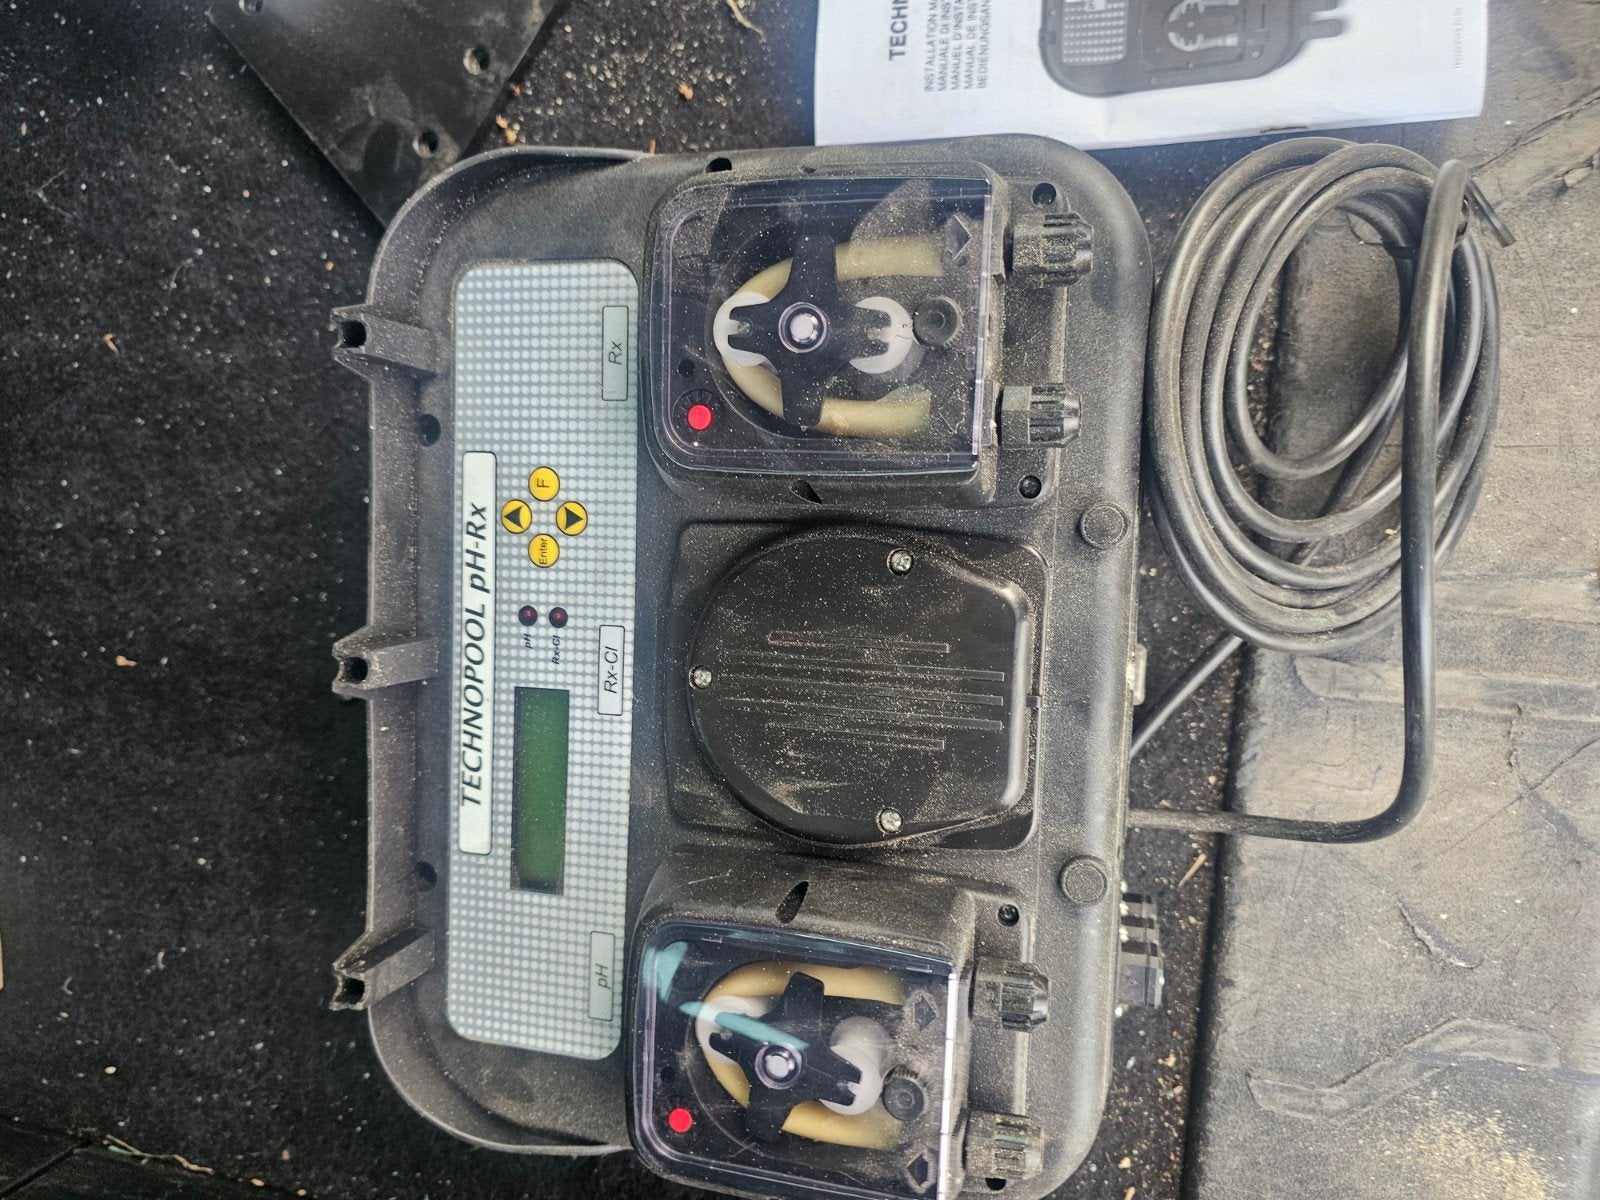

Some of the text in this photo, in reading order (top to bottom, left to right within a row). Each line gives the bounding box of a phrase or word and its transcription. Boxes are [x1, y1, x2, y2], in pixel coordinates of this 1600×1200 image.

[940, 24, 950, 34] DI
[966, 25, 977, 40] DE
[924, 14, 937, 92] INSTALLATION
[937, 38, 949, 91] MANUALE
[951, 45, 962, 90] MANUEL
[963, 45, 975, 89] MANUAL
[608, 341, 622, 365] Rx
[536, 477, 550, 488] F
[539, 538, 548, 565] Enter
[462, 502, 490, 806] TECHNOPOOL pH-Rx
[524, 633, 534, 650] pH
[604, 646, 619, 694] Rx-Cl
[595, 963, 612, 990] pH
